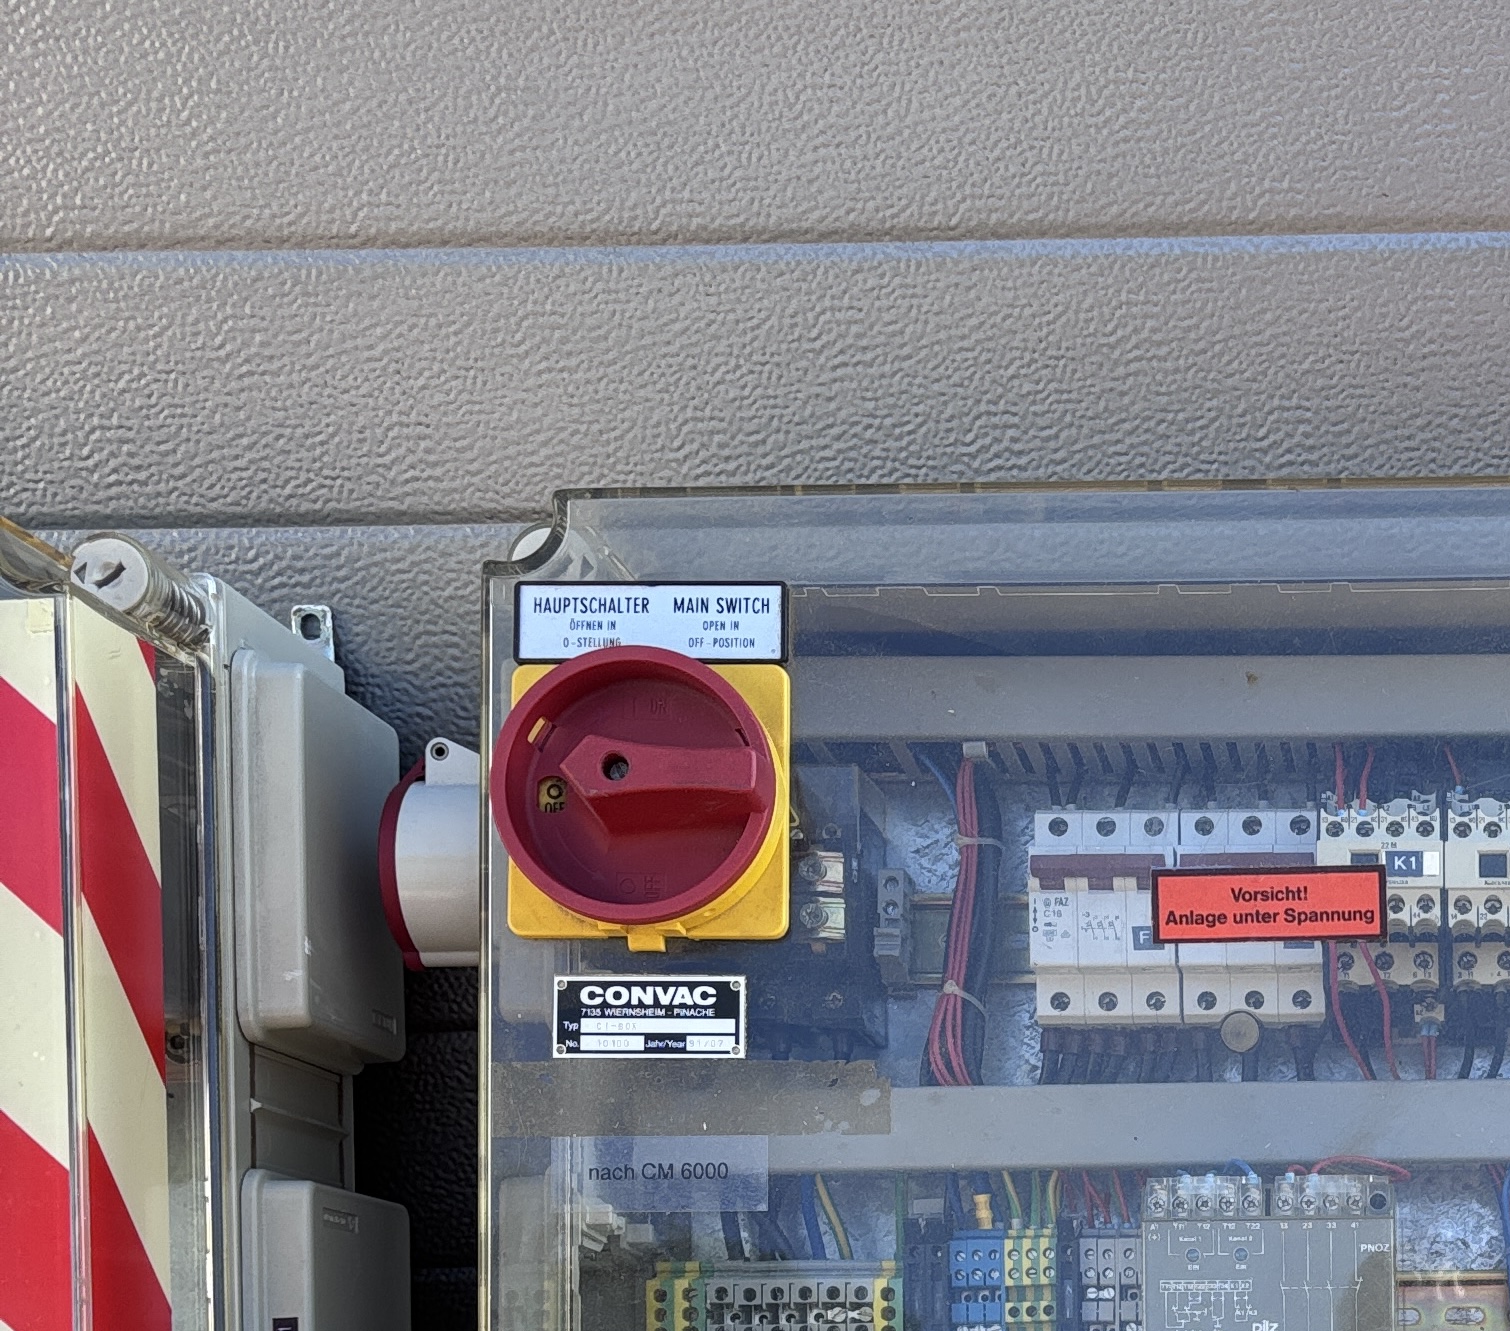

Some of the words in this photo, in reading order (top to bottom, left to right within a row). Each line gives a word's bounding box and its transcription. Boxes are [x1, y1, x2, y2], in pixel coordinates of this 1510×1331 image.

[534, 597, 650, 614] HAUPTSCHALTER
[673, 597, 709, 614] MAIN
[716, 597, 770, 614] SWITCH
[569, 618, 603, 631] ÖFFNEN
[607, 621, 617, 631] IN
[702, 621, 726, 631] OPEN
[730, 621, 739, 631] IN
[1393, 855, 1420, 870] K1
[1230, 886, 1308, 903] Vorsicht!
[1165, 910, 1228, 927] Anlage
[1233, 909, 1280, 924] unter
[1284, 908, 1375, 926] Spannung
[580, 985, 717, 1006] CONVAC
[673, 1008, 716, 1017] PINACHE
[563, 1021, 579, 1032] Typ
[565, 1039, 580, 1047] No.
[645, 1039, 686, 1048] Jahr/Year
[589, 1164, 635, 1180] nach
[641, 1162, 674, 1180] CM
[681, 1161, 729, 1180] 6000
[1360, 1243, 1390, 1252] PNOZ
